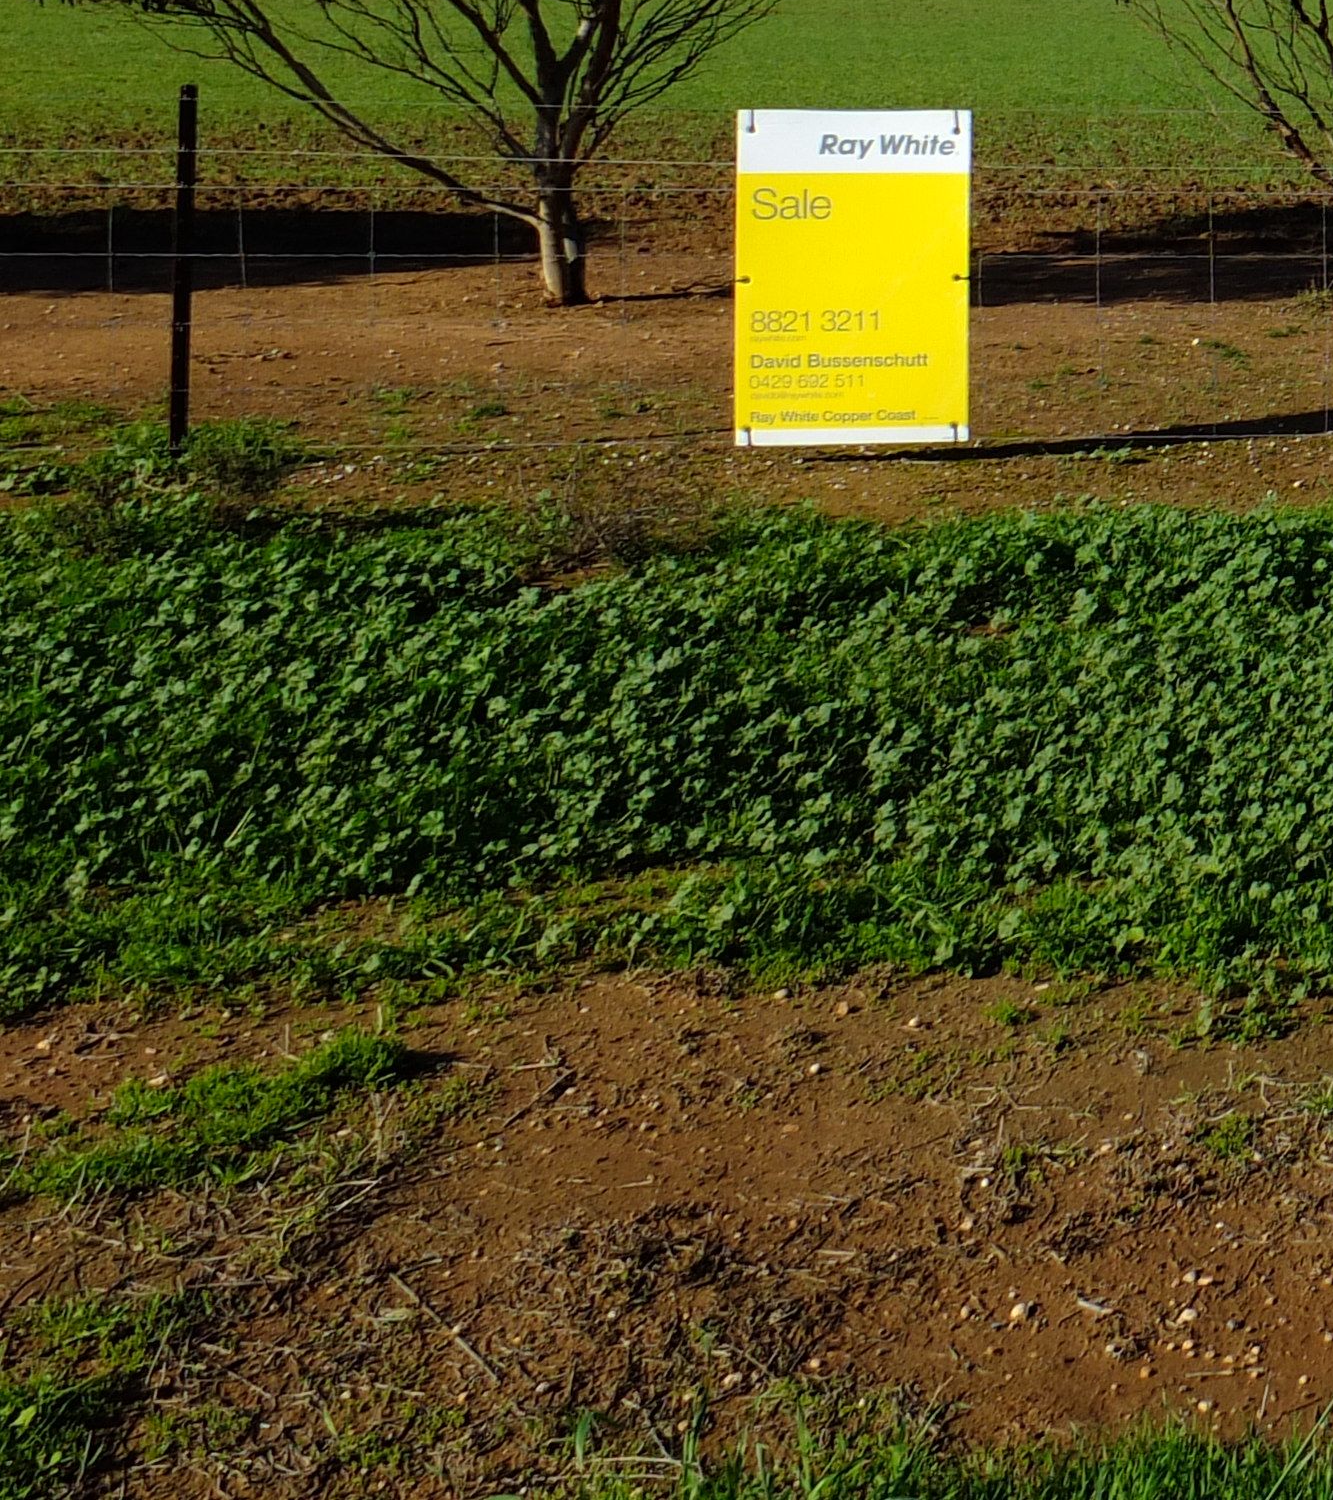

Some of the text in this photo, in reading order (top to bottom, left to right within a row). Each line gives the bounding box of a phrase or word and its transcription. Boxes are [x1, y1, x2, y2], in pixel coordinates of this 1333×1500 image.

[819, 133, 956, 160] Ray White
[751, 187, 832, 220] Sale
[750, 309, 880, 333] 8821 3211
[750, 352, 929, 369] David Bussenschutt
[749, 374, 792, 390] 0429
[835, 373, 865, 388] 511
[750, 411, 778, 425] Ray
[780, 410, 819, 422] White
[822, 409, 873, 425] Copper
[876, 408, 917, 421] Coast
